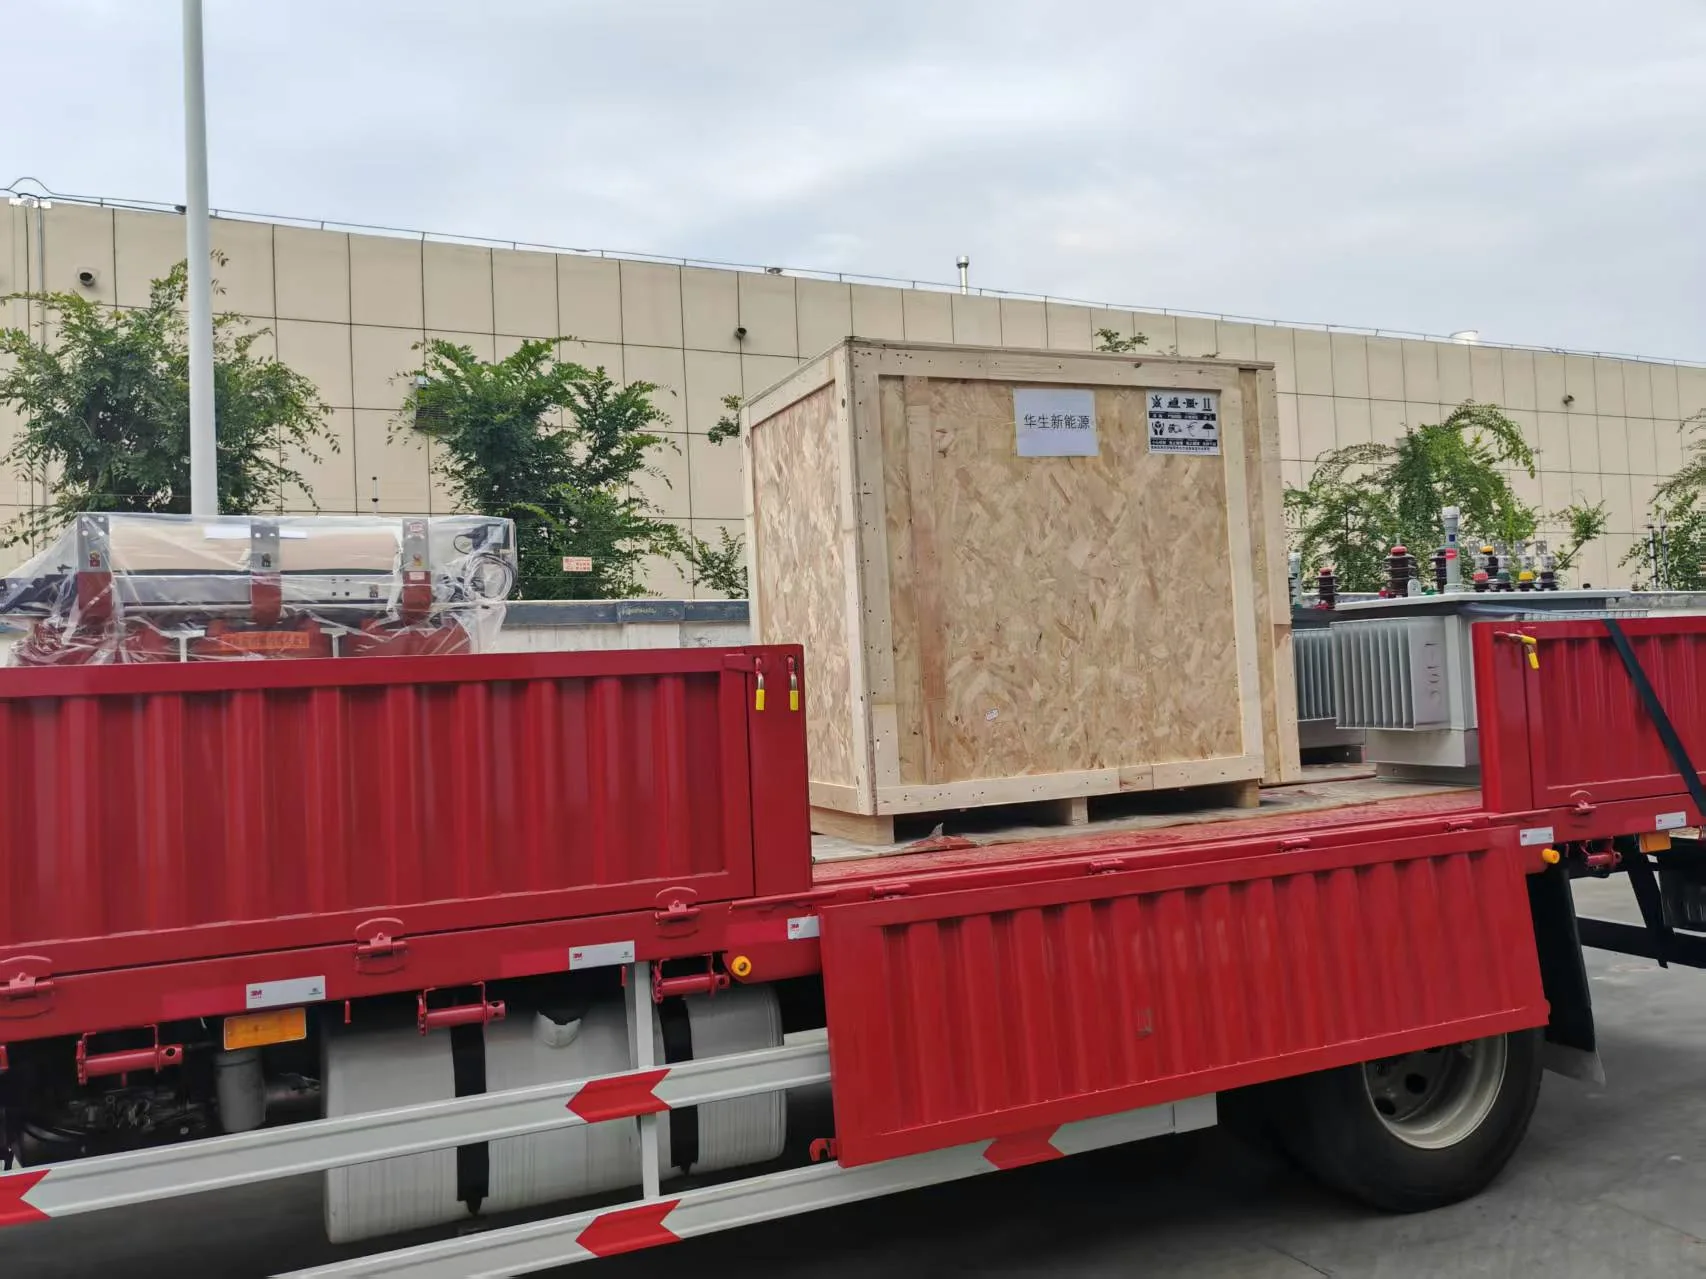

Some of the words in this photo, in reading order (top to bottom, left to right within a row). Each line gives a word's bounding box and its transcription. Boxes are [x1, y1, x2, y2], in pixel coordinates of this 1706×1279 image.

[1023, 413, 1091, 430] 华生新能源
